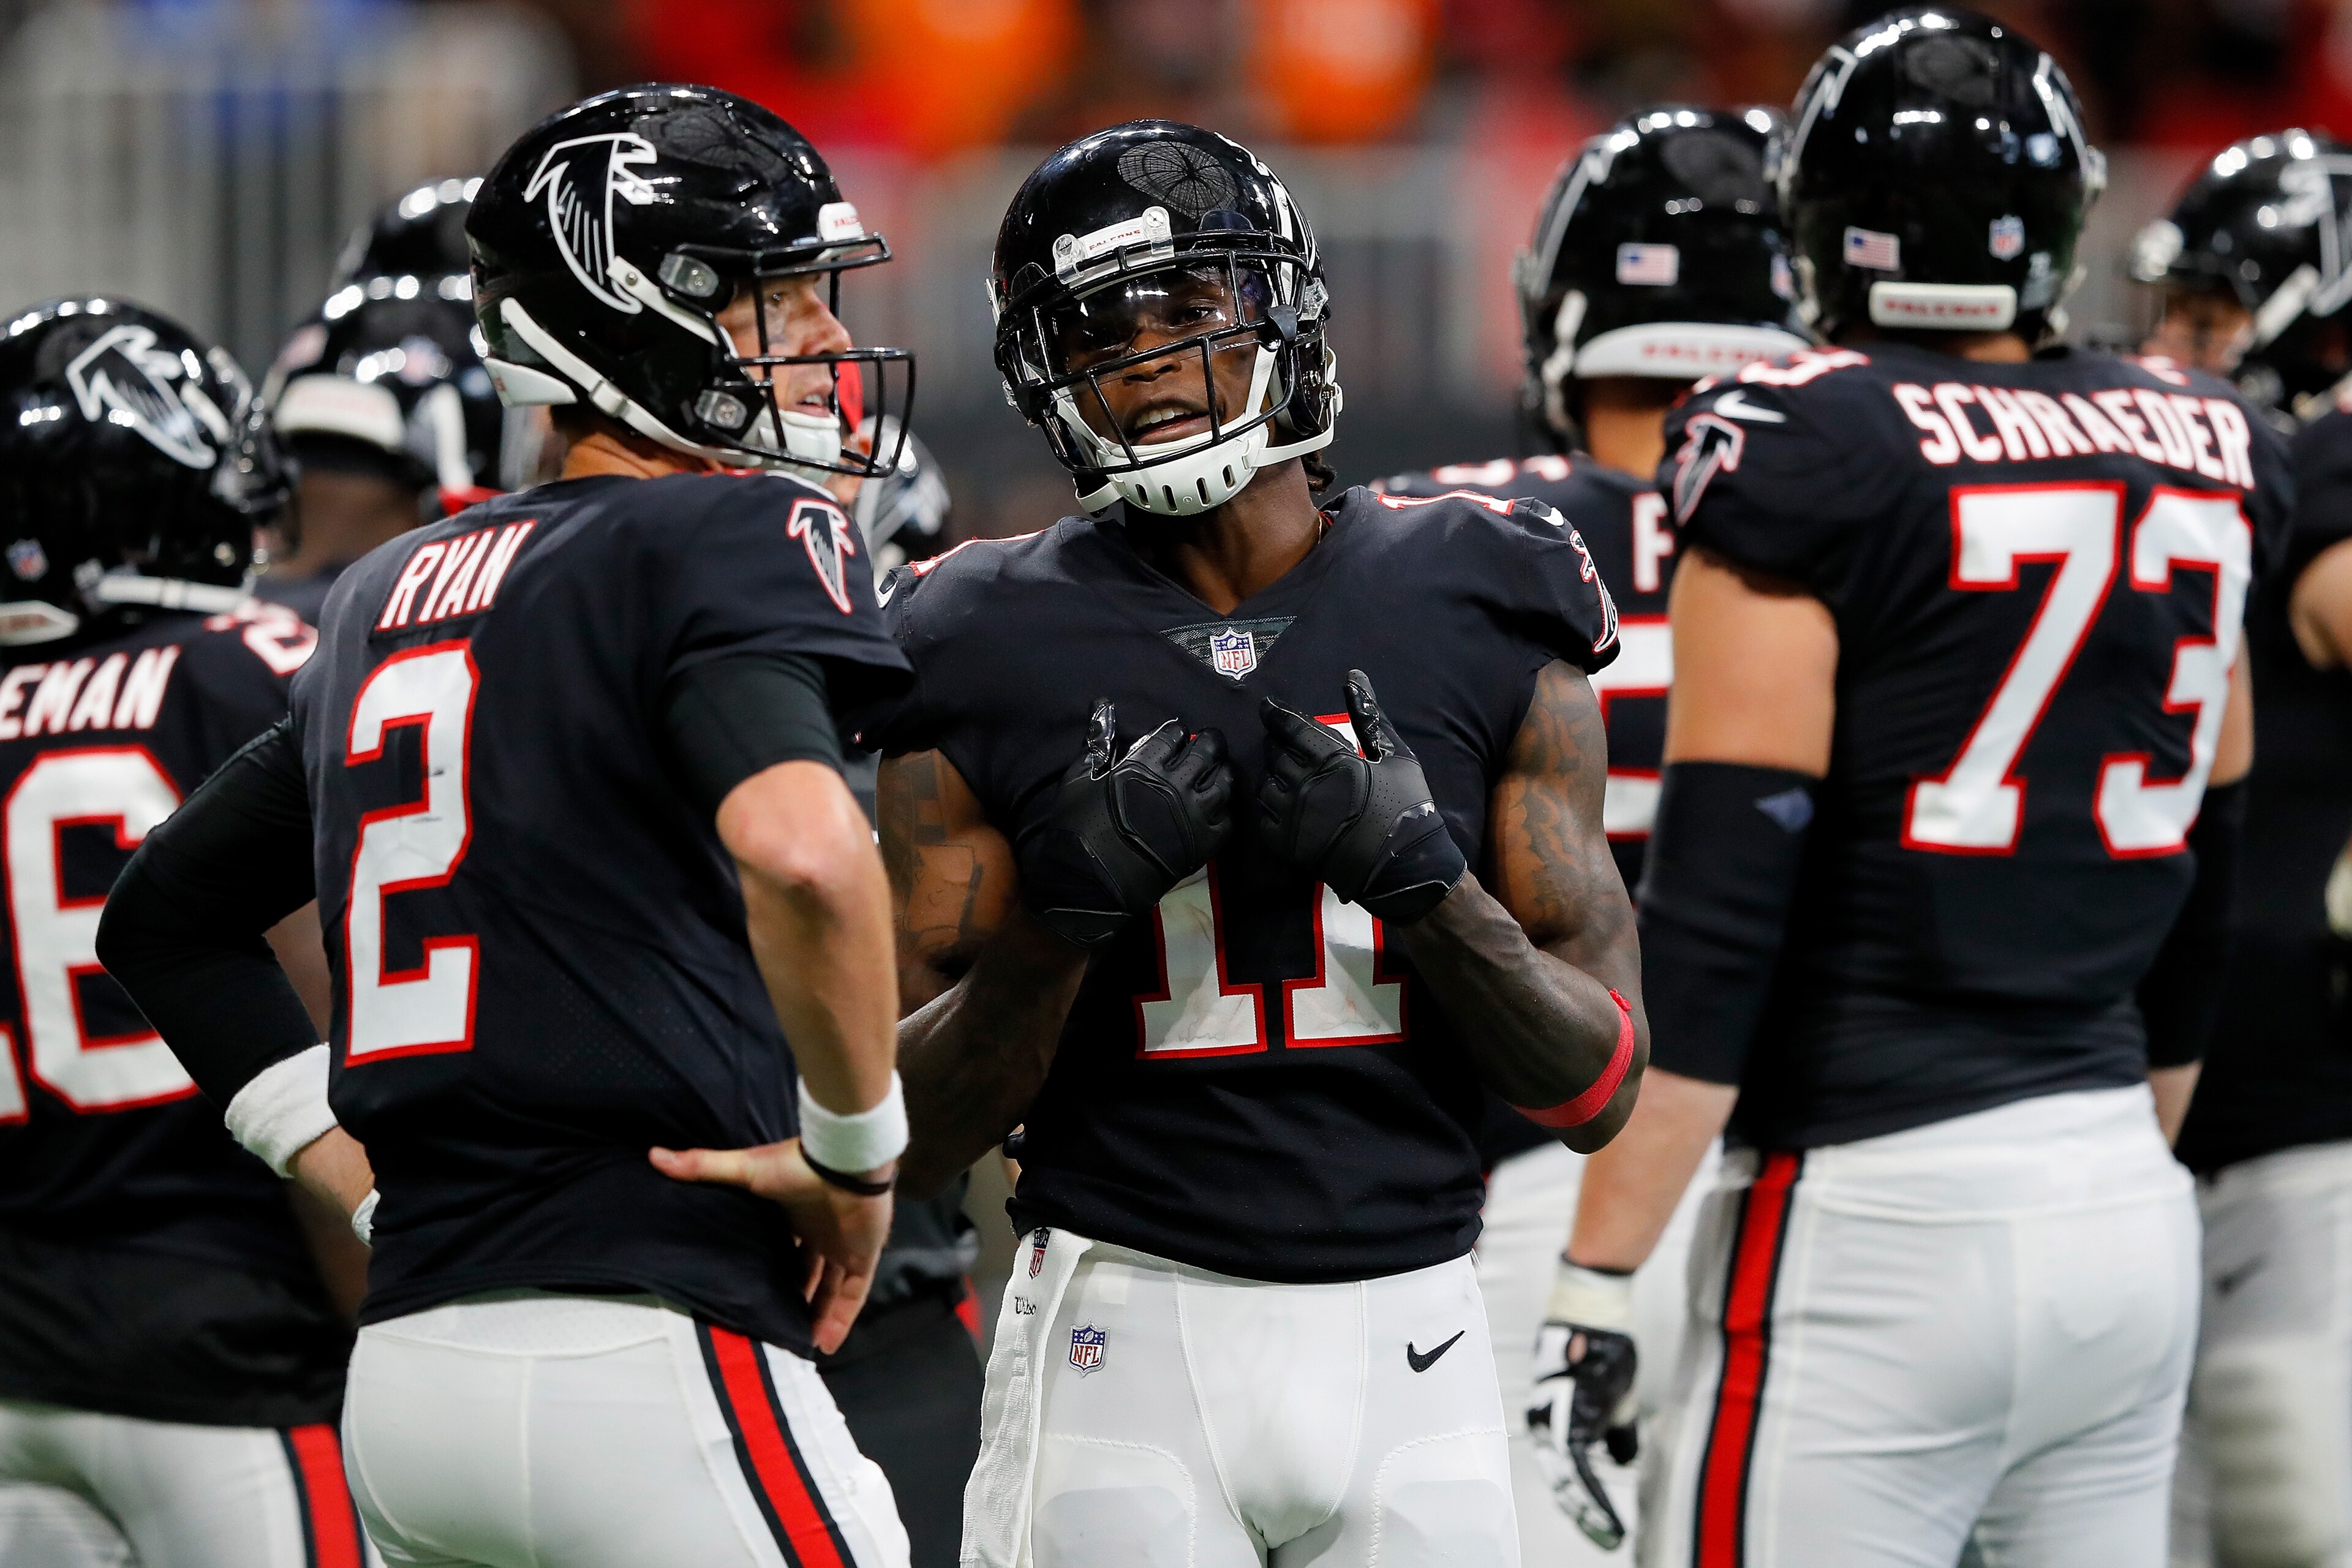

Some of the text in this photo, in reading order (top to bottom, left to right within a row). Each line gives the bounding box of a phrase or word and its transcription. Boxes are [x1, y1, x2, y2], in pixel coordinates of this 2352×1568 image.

[1089, 229, 1140, 251] FALCONS
[1893, 382, 2255, 489] SCHRAEDER
[375, 518, 538, 631] RYAN
[1221, 650, 1250, 670] NFL
[1900, 480, 2253, 859] 73
[344, 638, 480, 1066] 2
[1072, 1344, 1100, 1366] NFL
